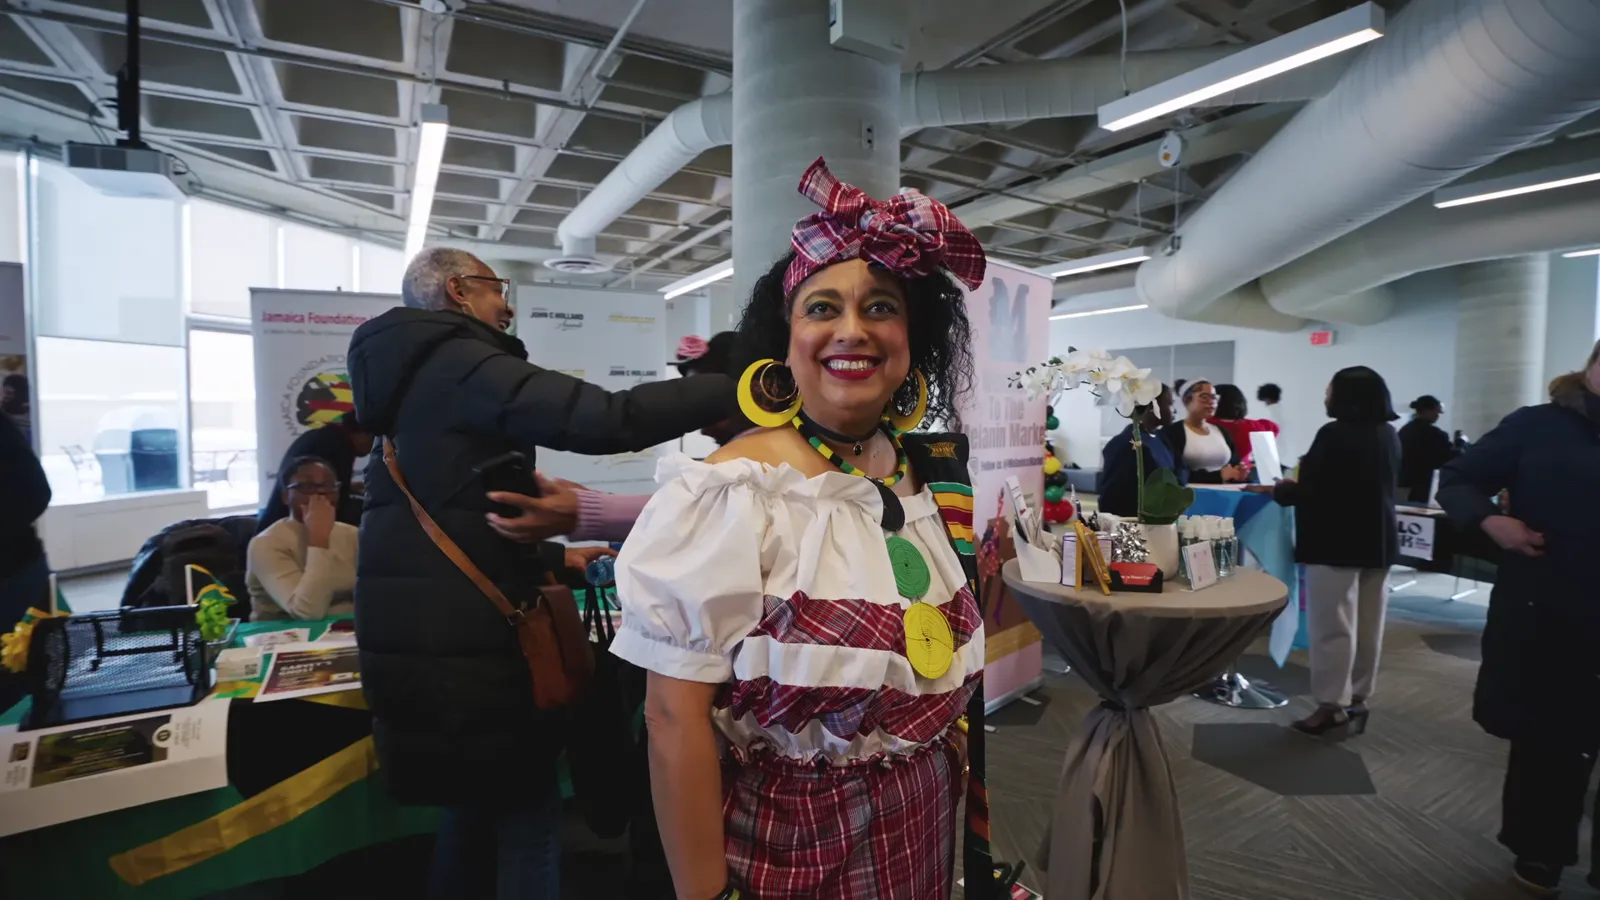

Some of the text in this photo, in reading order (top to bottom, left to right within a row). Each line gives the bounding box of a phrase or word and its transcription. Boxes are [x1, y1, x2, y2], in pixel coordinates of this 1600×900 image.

[262, 310, 305, 323] Jamaica
[308, 312, 367, 325] Foundation
[530, 311, 548, 319] JOHN
[555, 312, 584, 320] HOLLAND
[286, 354, 346, 392] FOUNDATIO
[988, 396, 1026, 422] To The
[1009, 422, 1046, 448] Marke
